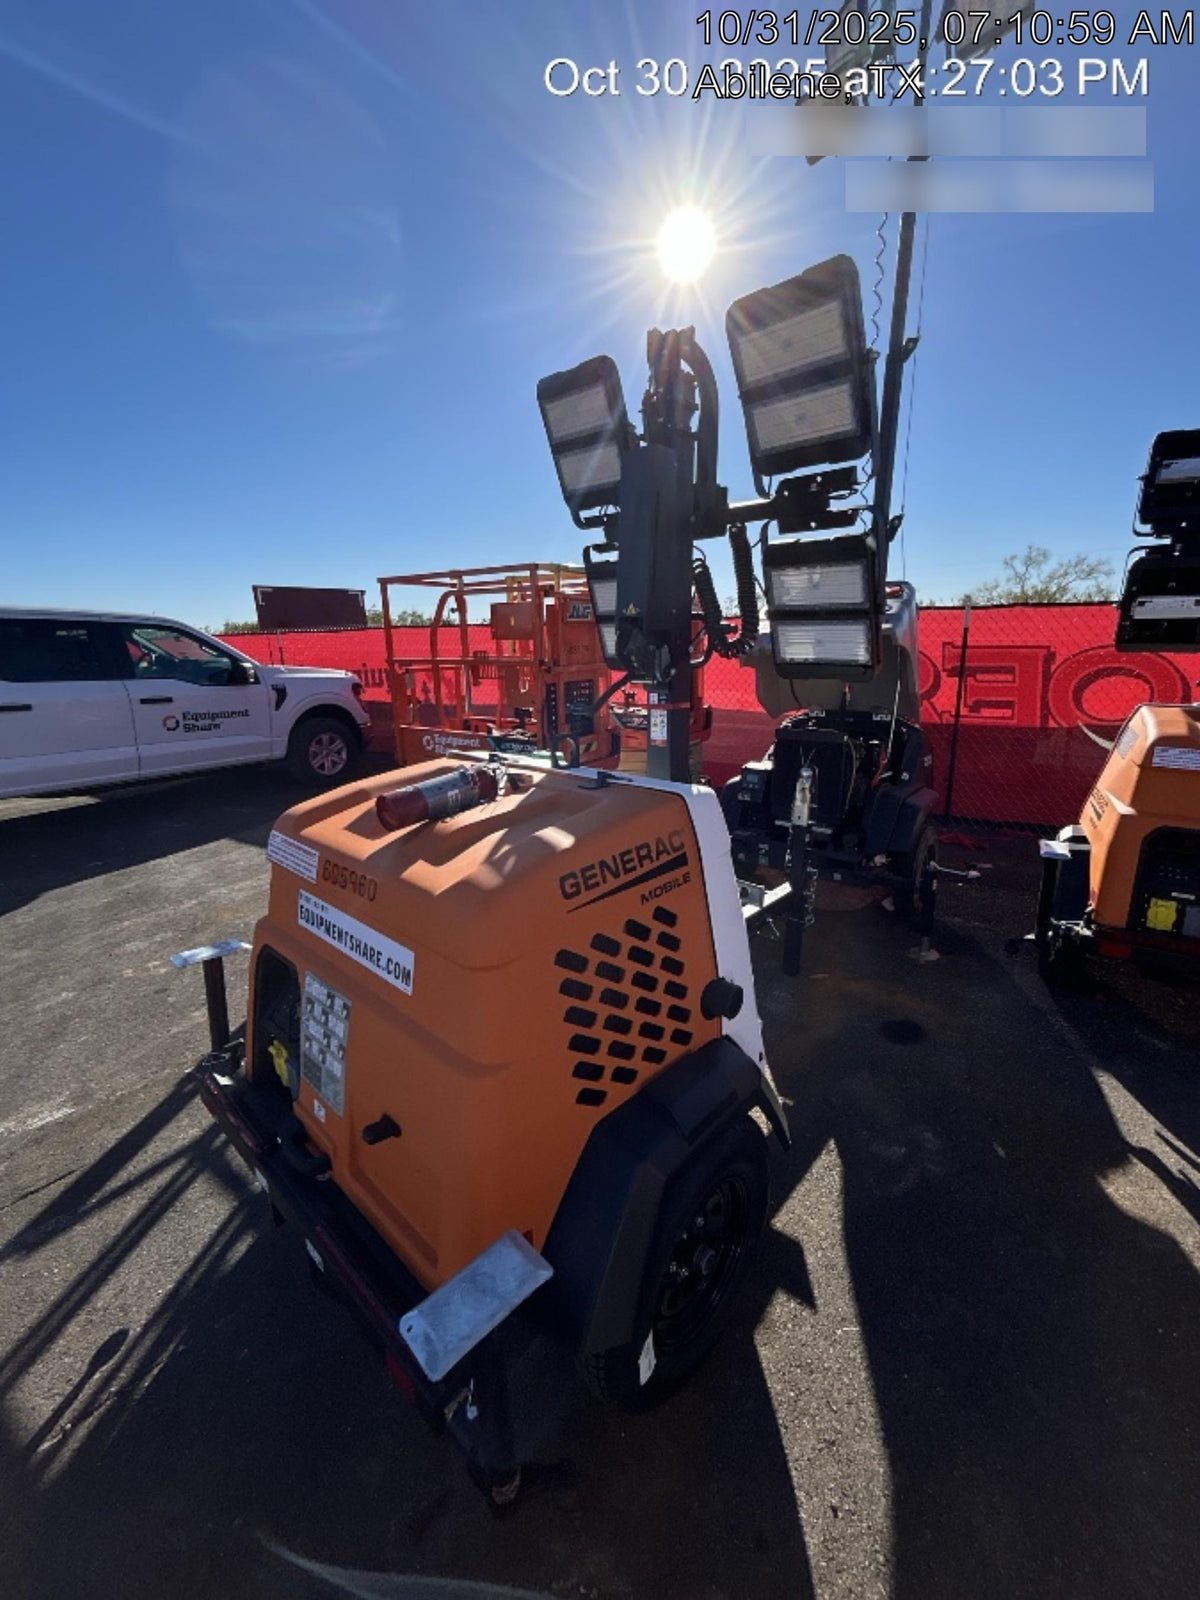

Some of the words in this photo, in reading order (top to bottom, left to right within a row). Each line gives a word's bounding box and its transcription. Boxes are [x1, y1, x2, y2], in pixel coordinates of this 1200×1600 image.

[181, 708, 250, 722] Equipment
[559, 829, 685, 900] GENERAC
[640, 872, 692, 904] MOBILE
[299, 904, 411, 987] EQUIPMENTSHARE.COM
